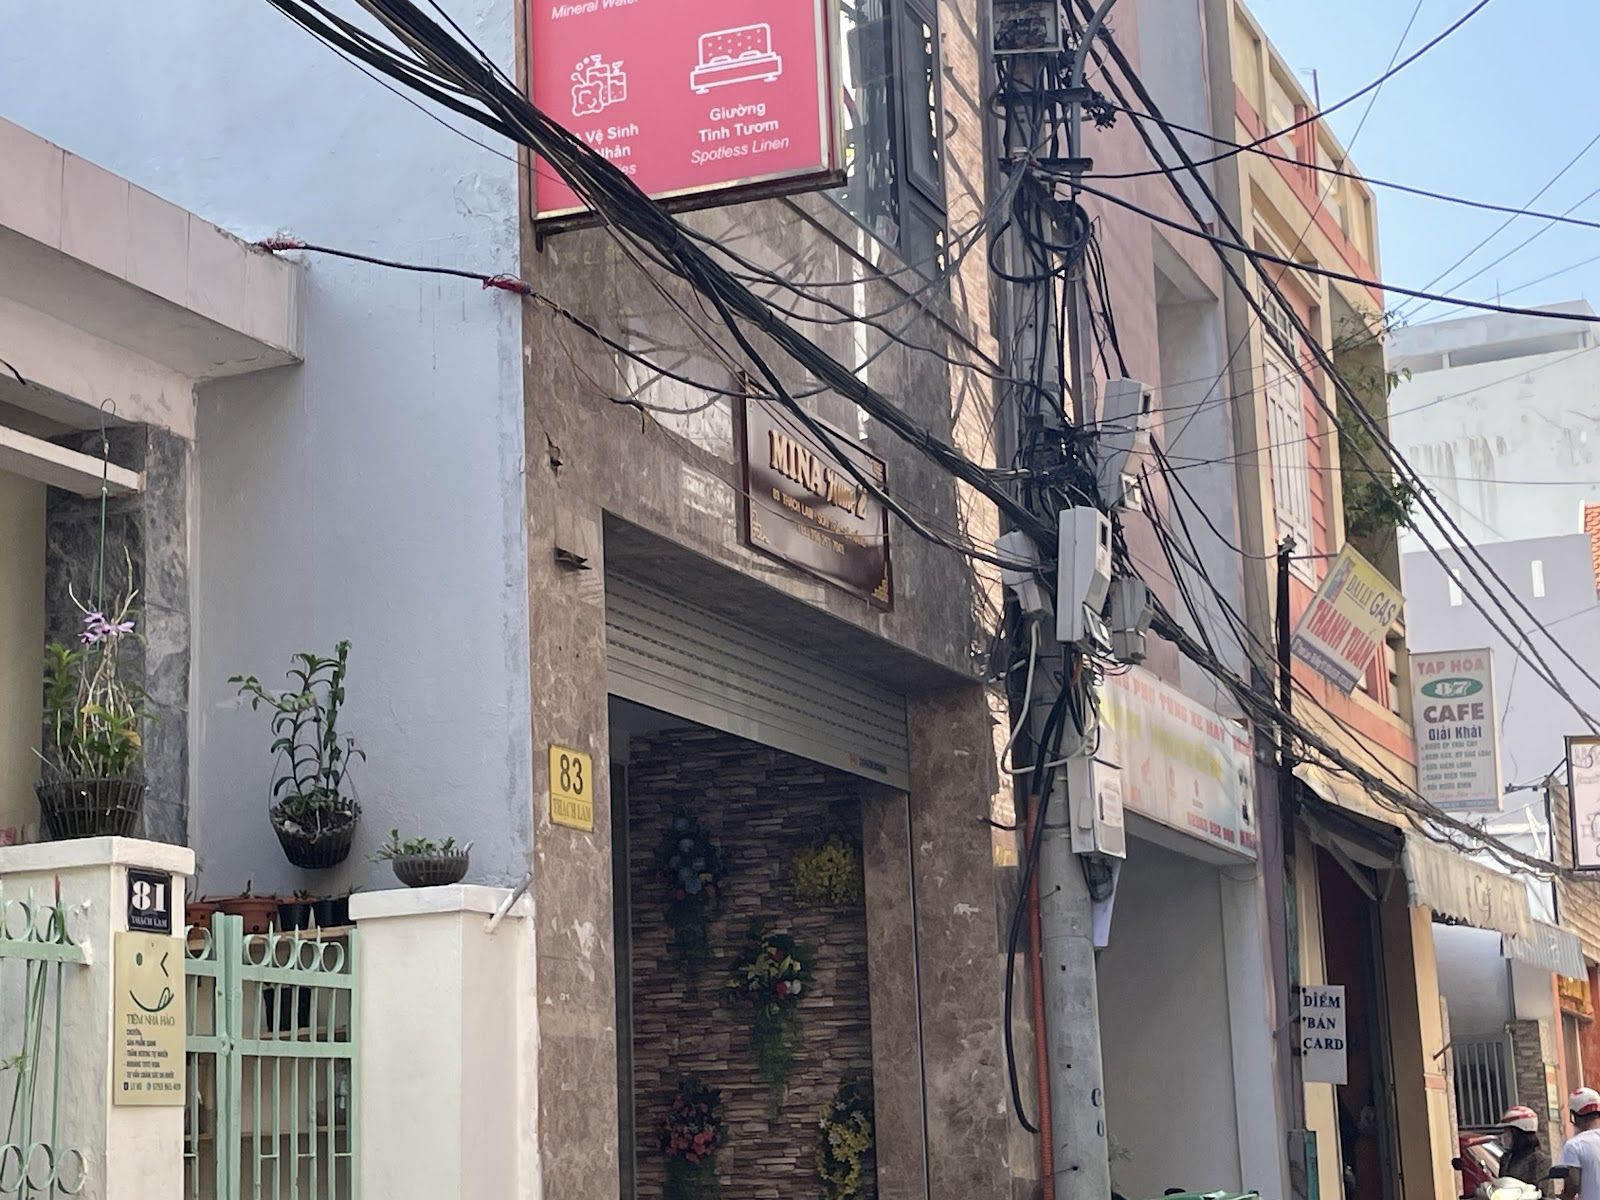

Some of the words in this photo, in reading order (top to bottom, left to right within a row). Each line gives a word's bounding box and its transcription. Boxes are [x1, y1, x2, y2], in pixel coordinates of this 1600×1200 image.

[551, 0, 599, 20] Mineral
[602, 0, 640, 9] Wate
[585, 129, 604, 145] Vệ
[607, 123, 639, 140] Sinh
[698, 126, 730, 143] Tinh
[691, 144, 749, 165] Spotless
[752, 137, 790, 154] Linen
[769, 430, 823, 496] MINA
[1369, 591, 1397, 627] GAS
[1306, 598, 1352, 651] THANH
[1423, 702, 1485, 724] CAFE
[560, 753, 583, 795] 83
[132, 880, 167, 913] 81
[1307, 1012, 1336, 1029] BÁN
[1303, 1037, 1344, 1050] CARD
